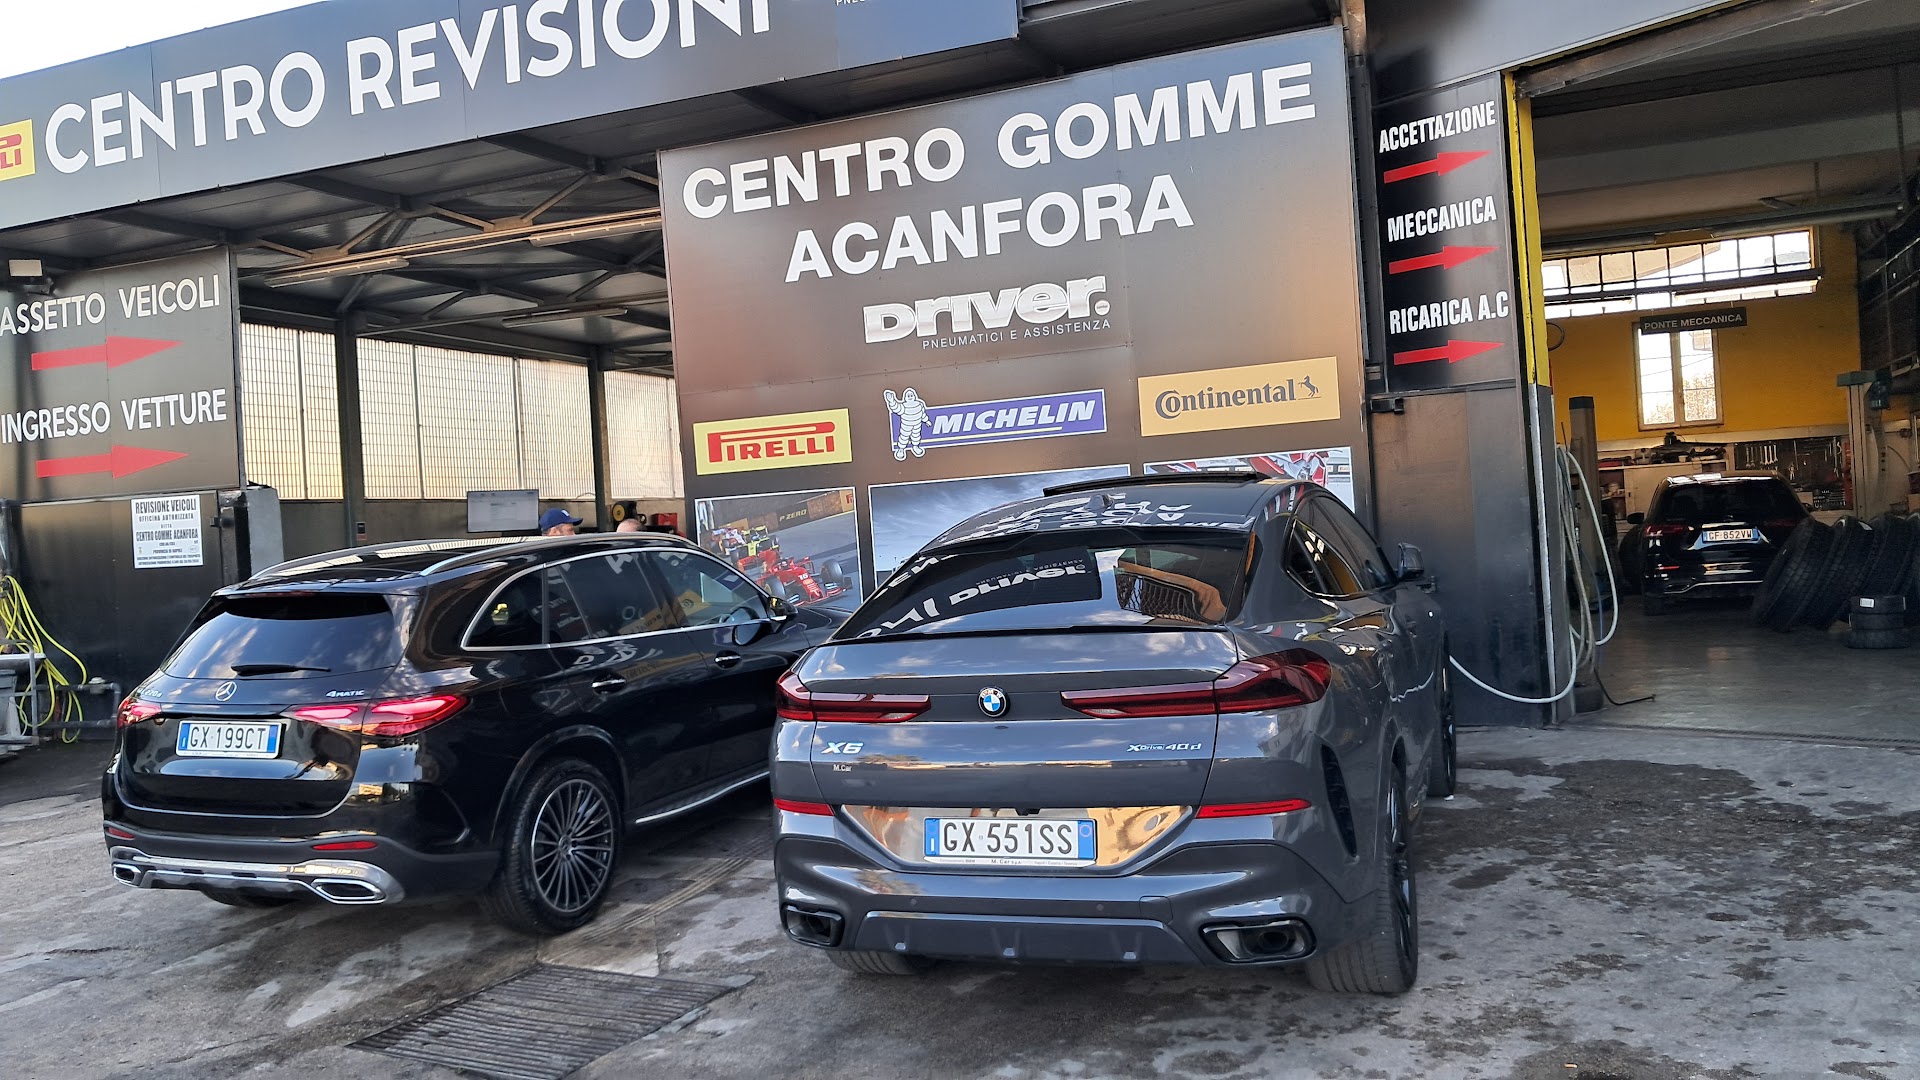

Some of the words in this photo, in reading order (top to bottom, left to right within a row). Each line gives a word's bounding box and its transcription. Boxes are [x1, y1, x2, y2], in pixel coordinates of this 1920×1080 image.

[45, 51, 325, 173] CENTRO
[1379, 101, 1497, 153] ACCETTAZIONE
[683, 128, 965, 219] CENTRO
[998, 61, 1316, 169] GOMME
[784, 174, 1194, 283] ACANFORA
[1387, 196, 1497, 242] MECCANICA
[0, 292, 106, 336] ASSETTO
[119, 275, 220, 318] VEICOLI
[1389, 294, 1474, 334] RICARICA
[1644, 320, 1678, 330] PONTE
[1680, 314, 1742, 327] MECCANICA
[922, 332, 1004, 350] PNEUMATICI
[1010, 330, 1017, 340] E
[1024, 320, 1111, 339] ASSISTENZA
[1, 401, 111, 443] INGRESSO
[121, 389, 227, 430] VETTURE
[932, 400, 1097, 435] MICHELIN
[1155, 379, 1296, 419] Continental
[707, 422, 836, 463] PIRELLI
[135, 500, 169, 514] REVISIONE
[171, 498, 196, 512] VEICOLI
[326, 690, 365, 698] 4MATIC
[190, 727, 210, 748] GX
[216, 727, 266, 749] 199CT
[821, 742, 864, 754] X6
[944, 822, 975, 852] GX
[987, 823, 1072, 854] 551SS
